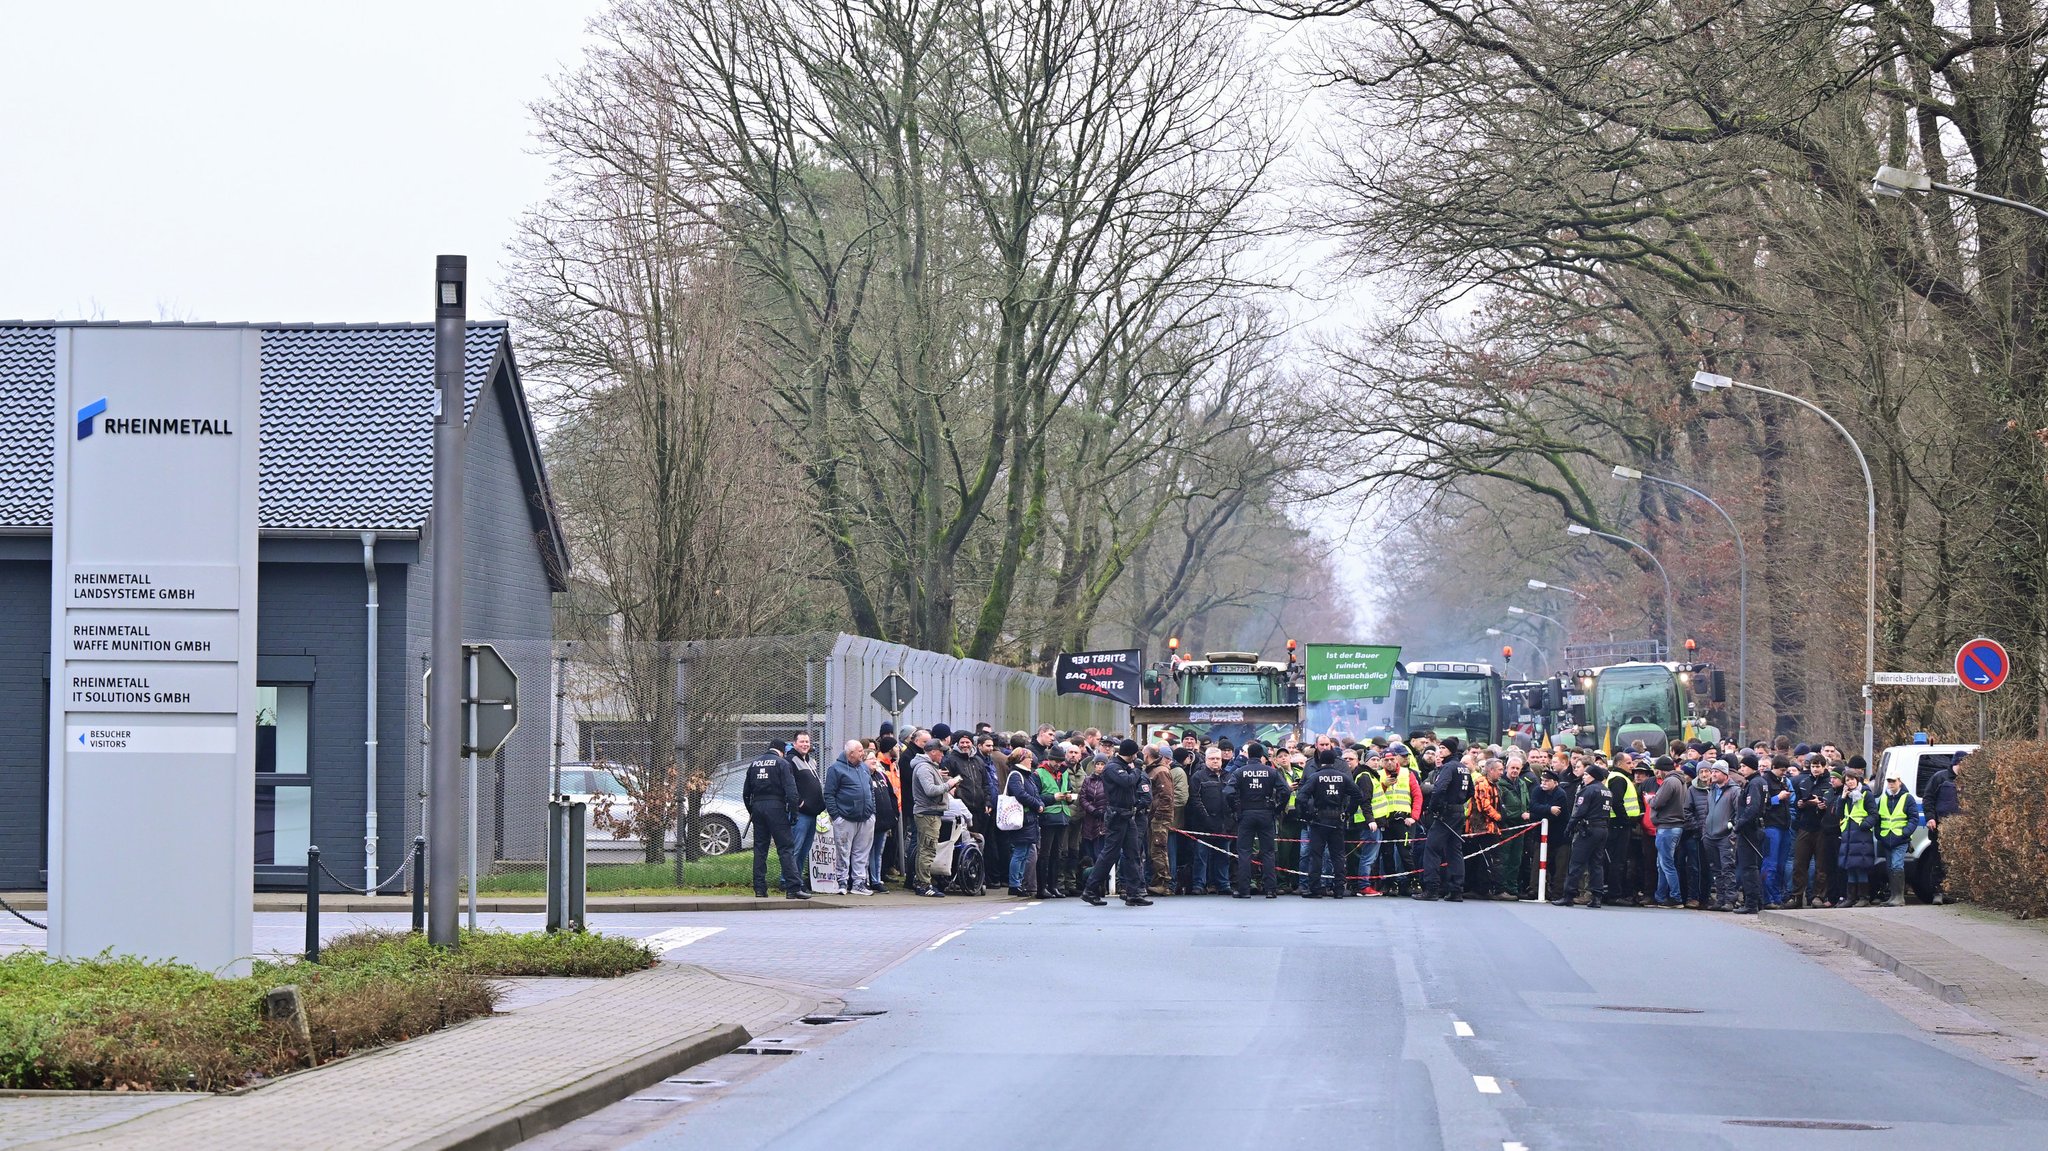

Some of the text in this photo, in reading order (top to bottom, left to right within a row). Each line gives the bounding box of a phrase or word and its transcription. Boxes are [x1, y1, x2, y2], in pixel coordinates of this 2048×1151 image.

[105, 418, 232, 435] RHEINMETALL
[74, 574, 151, 584] RHEINMETALL
[74, 588, 195, 599] LANDSYSTEME GMBH
[73, 625, 151, 636] RHEINMETALL
[73, 640, 211, 651] WAFFE MUNITION GMBH
[73, 677, 150, 688] RHEINMETALL
[1311, 673, 1328, 681] wird
[72, 692, 190, 703] IT SOLUTIONS GMBH
[90, 740, 127, 748] VISITORS
